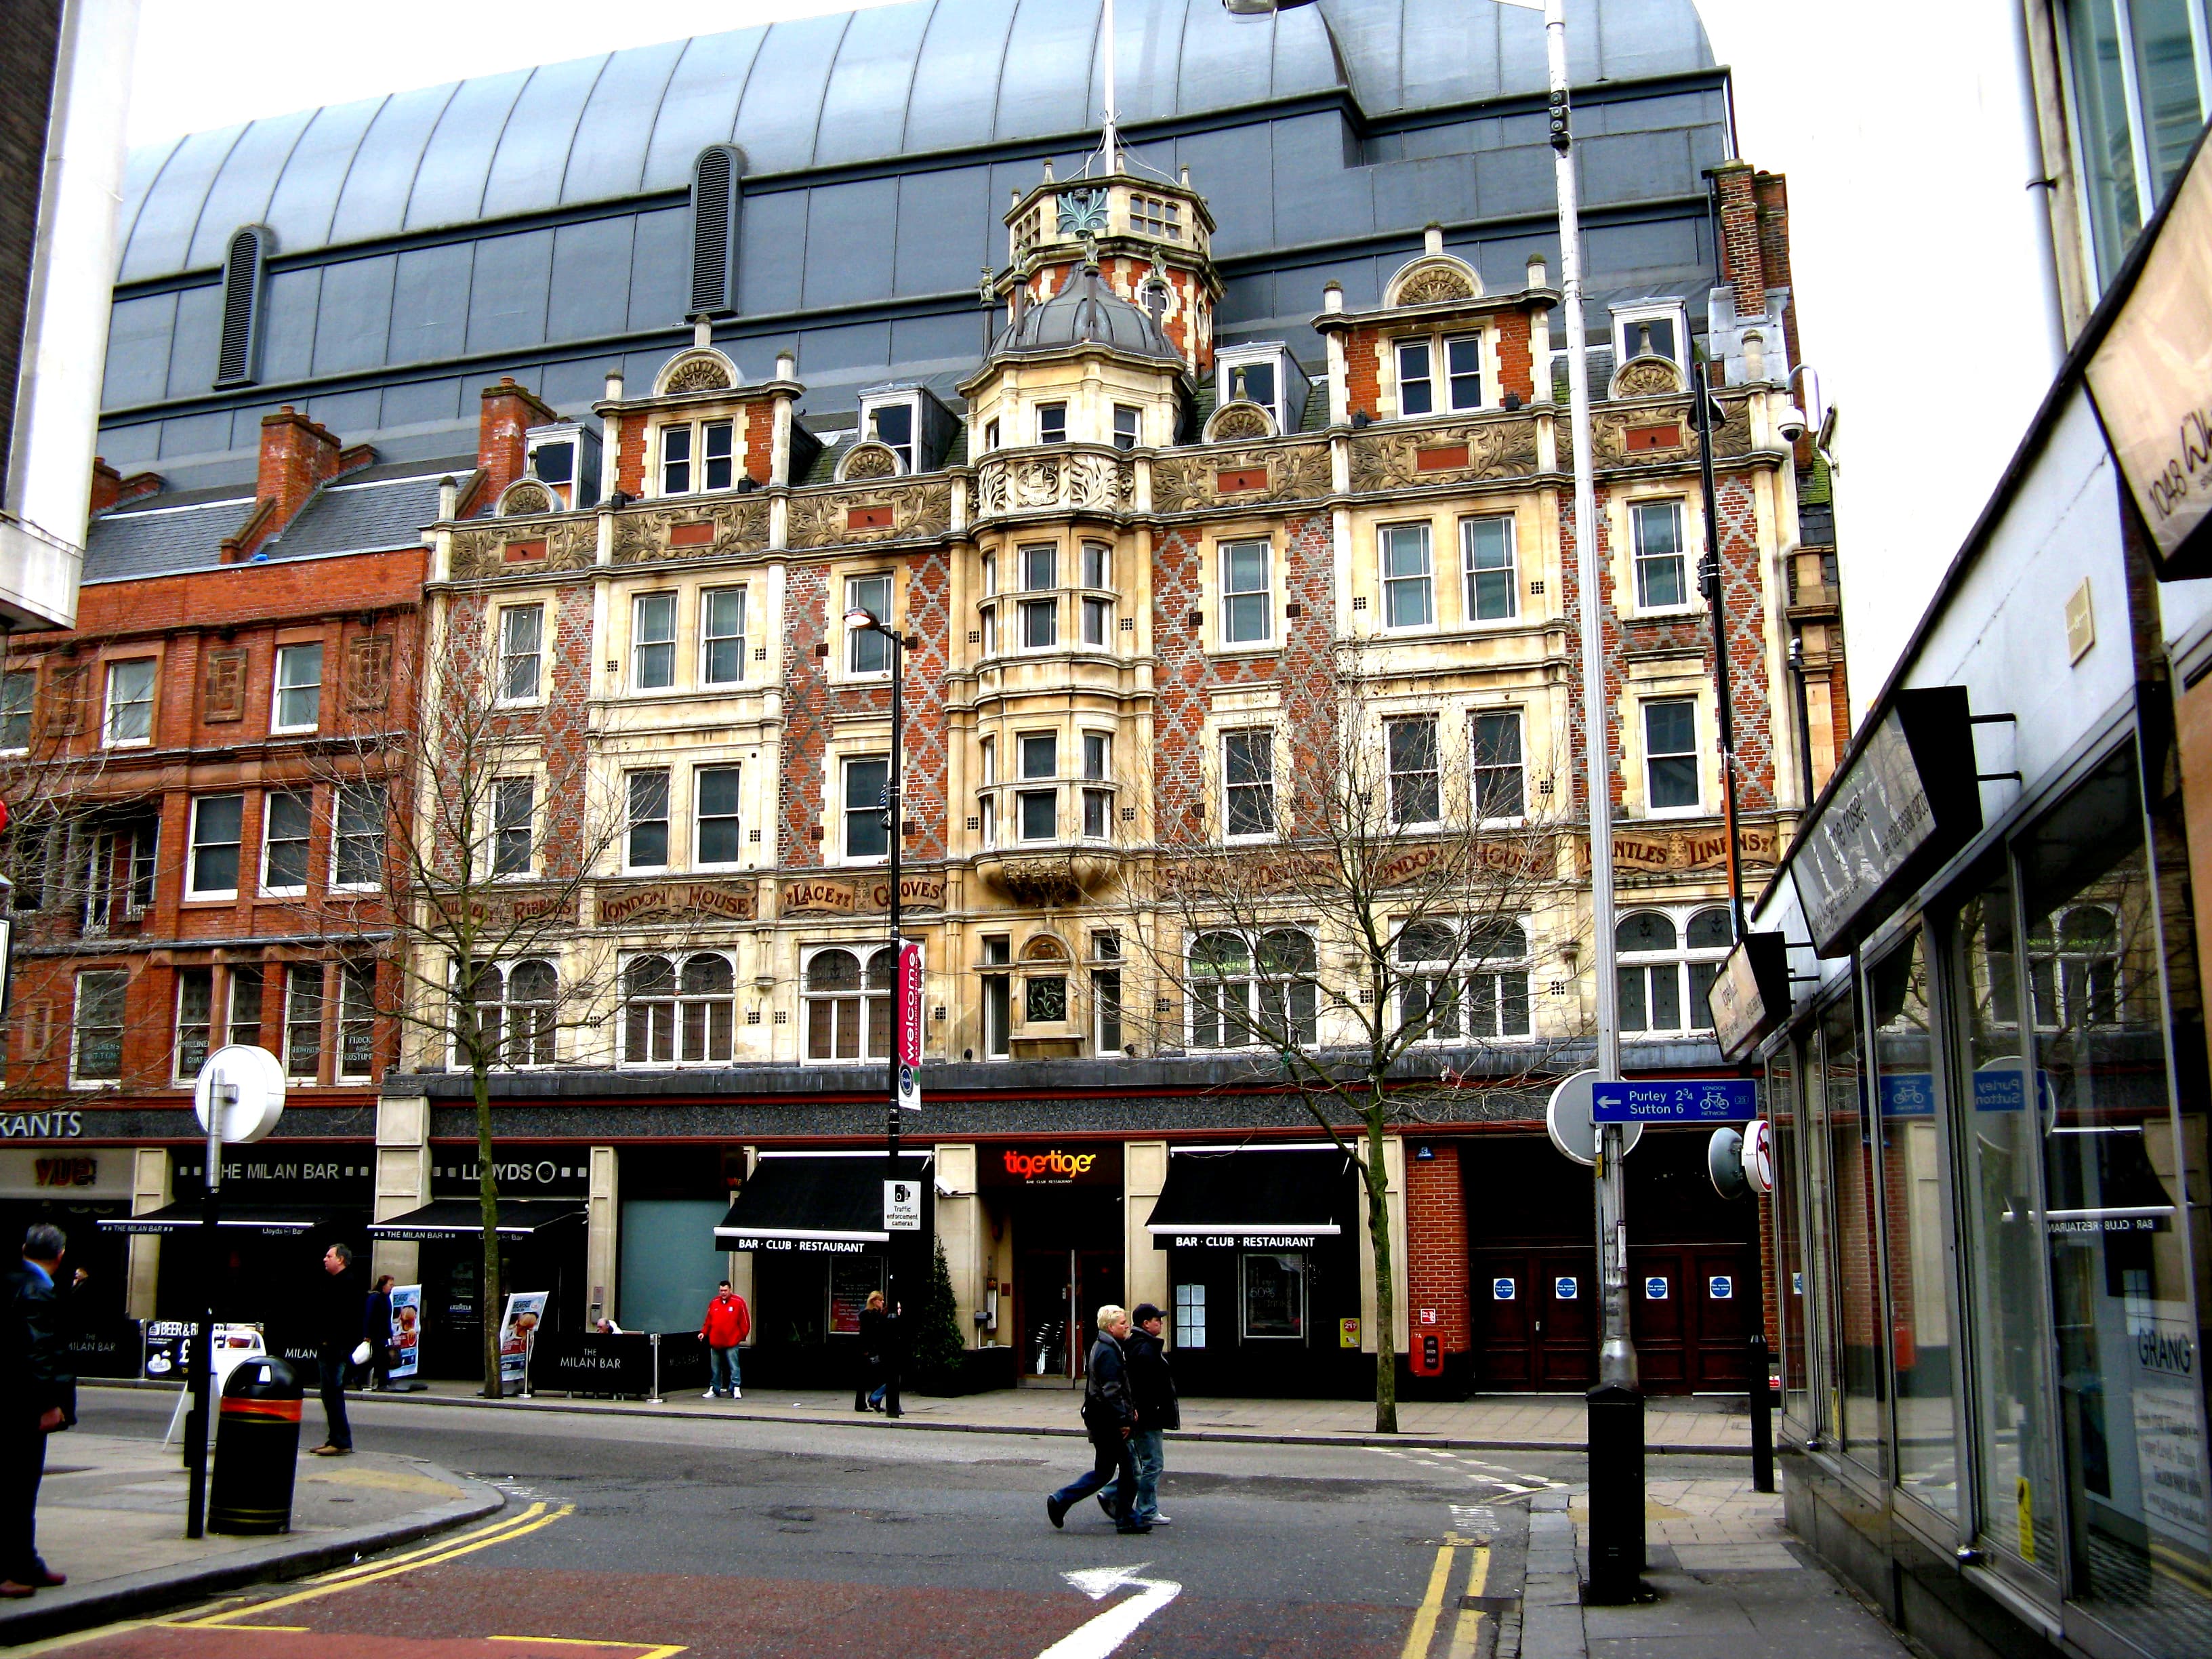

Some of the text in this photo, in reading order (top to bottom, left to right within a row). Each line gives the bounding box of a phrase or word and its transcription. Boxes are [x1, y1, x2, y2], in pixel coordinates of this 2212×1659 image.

[1584, 841, 1666, 864] NTLES
[689, 885, 749, 914] HOUSE
[792, 881, 939, 907] LACE GOVES
[905, 951, 916, 1061] welcome
[1629, 1091, 1666, 1102] Purley
[1630, 1104, 1684, 1113] Sutton 6
[221, 1164, 340, 1179] HE MILAN BAR
[739, 1239, 865, 1252] BAR CLUB RESTAURANT
[1176, 1237, 1315, 1247] BAR CLUB RESTAURANT
[161, 1322, 182, 1336] BEER
[285, 1348, 317, 1359] MILAN
[560, 1357, 621, 1368] MILAN BAR
